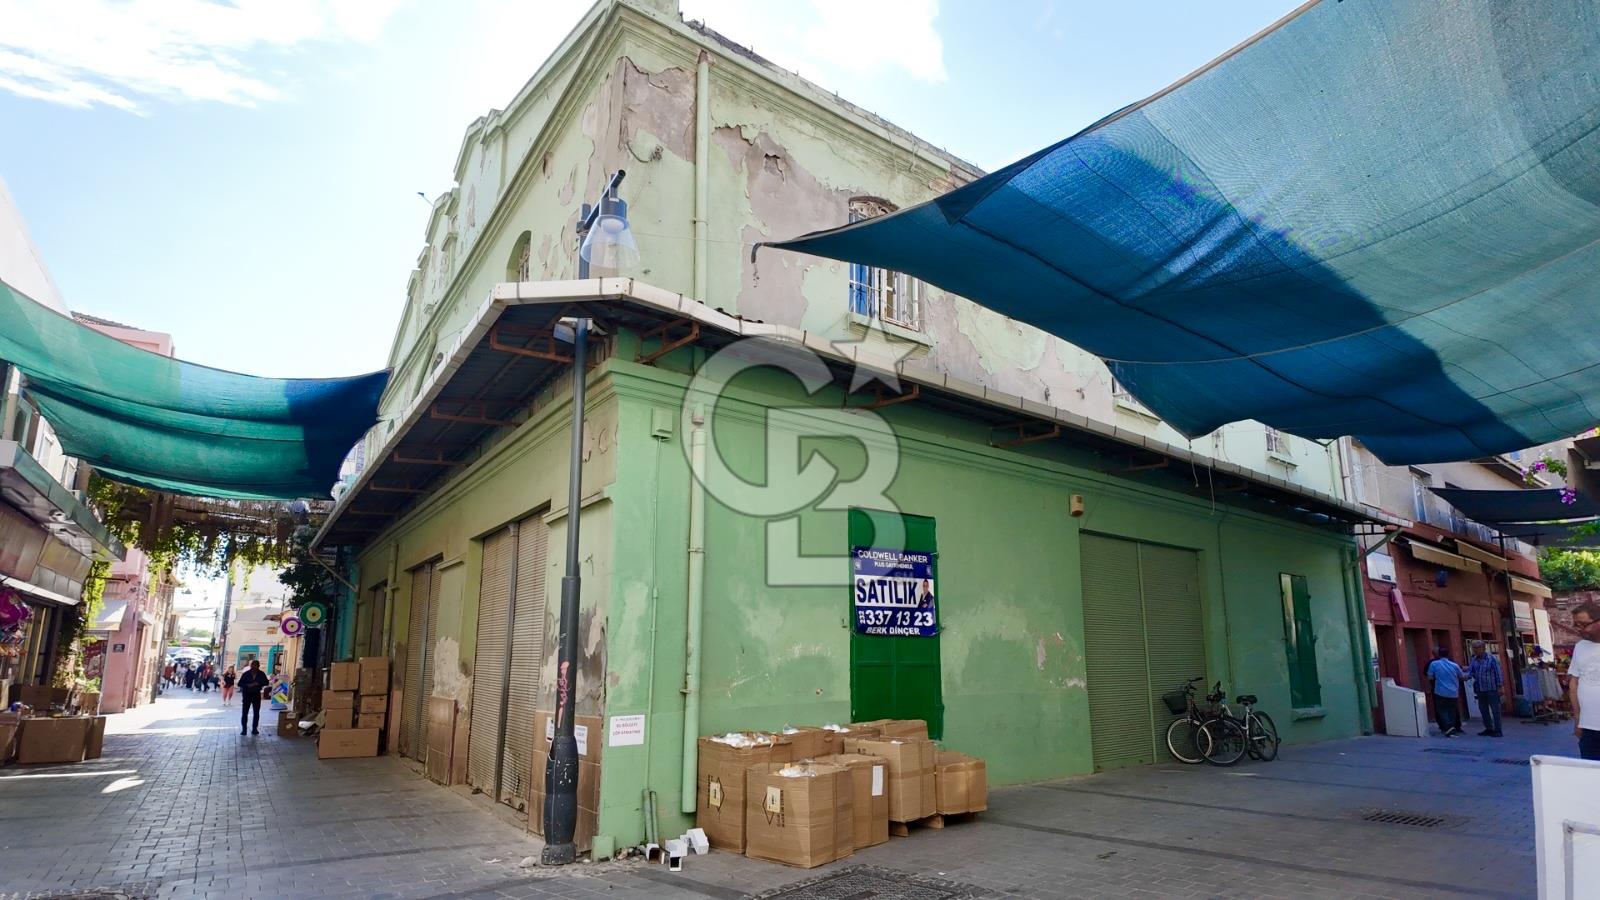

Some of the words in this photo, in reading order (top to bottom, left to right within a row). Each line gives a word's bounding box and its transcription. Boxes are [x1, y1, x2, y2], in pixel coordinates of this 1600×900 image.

[858, 550, 898, 561] COLDWELL
[898, 553, 928, 563] BANKER
[856, 577, 918, 605] SATILIK
[865, 609, 892, 625] 337
[896, 610, 911, 626] 13
[914, 611, 934, 627] 23
[866, 626, 887, 634] BERK
[889, 625, 921, 636] DİNÇER
